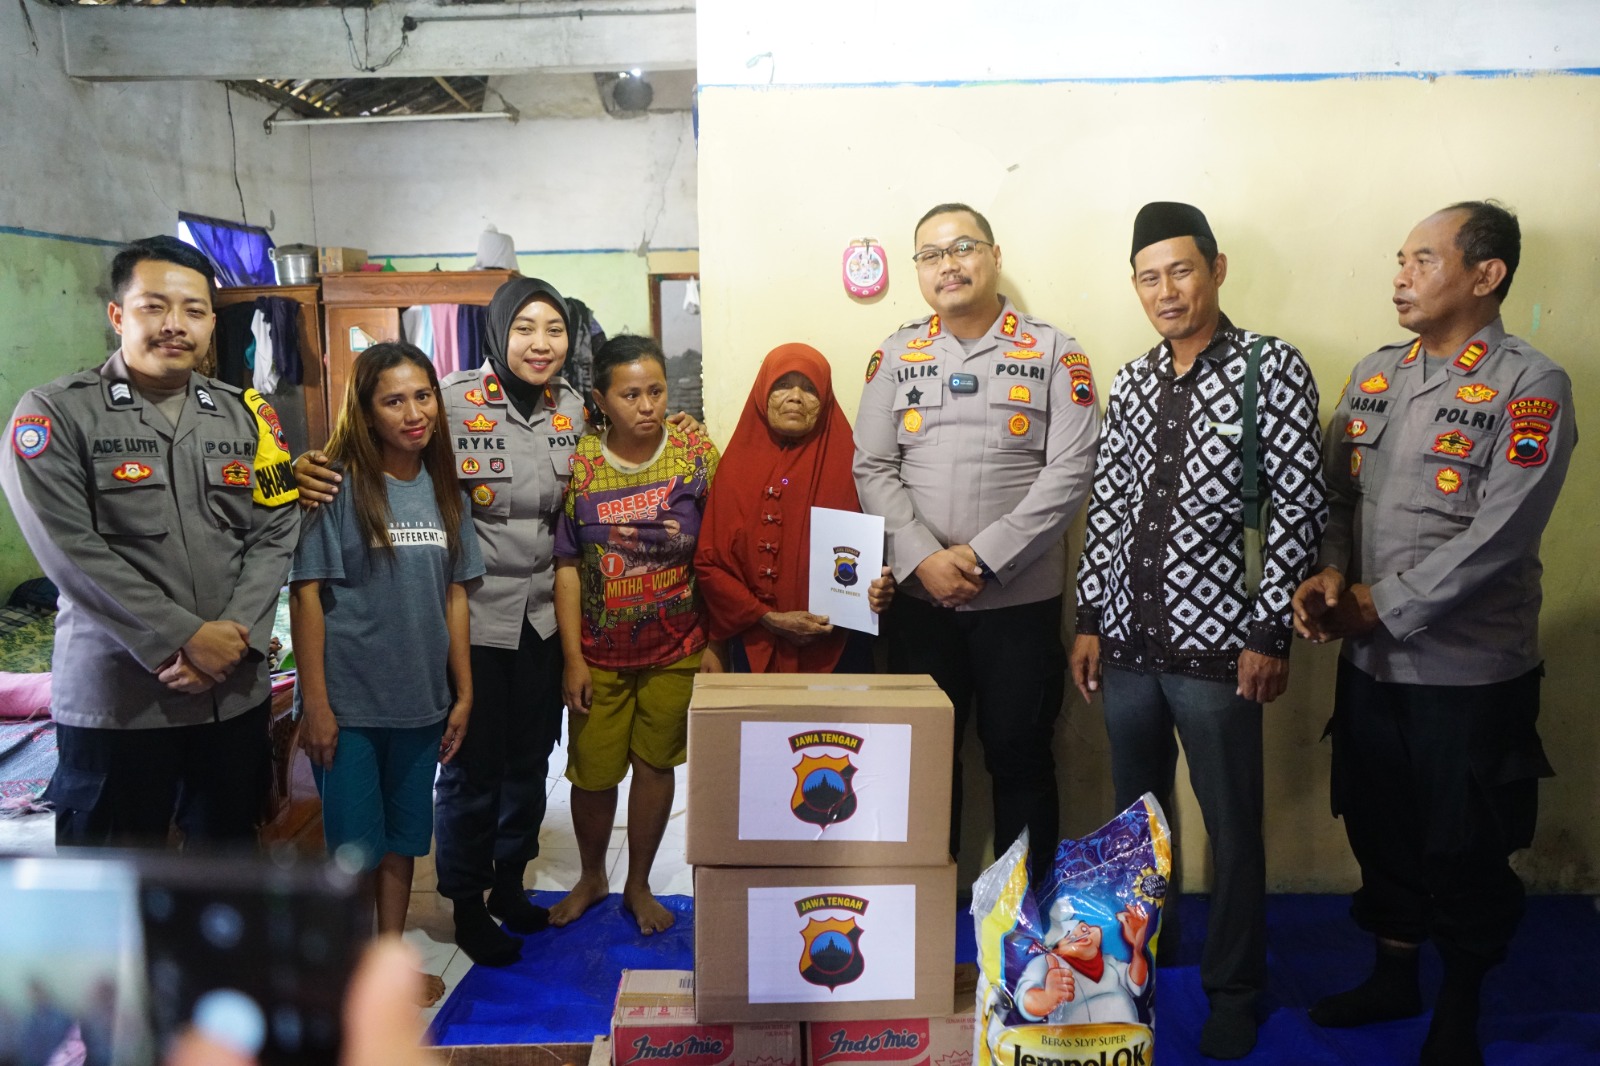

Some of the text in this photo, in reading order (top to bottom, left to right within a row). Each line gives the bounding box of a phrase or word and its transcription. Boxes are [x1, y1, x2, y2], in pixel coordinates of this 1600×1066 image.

[897, 365, 938, 382] LILIK
[996, 364, 1045, 380] POLRI
[1511, 400, 1553, 410] POLRES
[1515, 408, 1548, 416] BREBES
[1435, 407, 1496, 430] POLRI
[93, 439, 122, 453] ADE
[205, 440, 255, 456] POLRI
[458, 437, 506, 450] RYKE
[608, 557, 616, 573] 1
[607, 577, 644, 599] MITHA
[795, 733, 859, 748] JAWA TENGAH
[1143, 875, 1160, 886] BEST
[801, 896, 864, 912] JAWA TENGAH
[1041, 1034, 1127, 1047] BERAS SLYP SUPER
